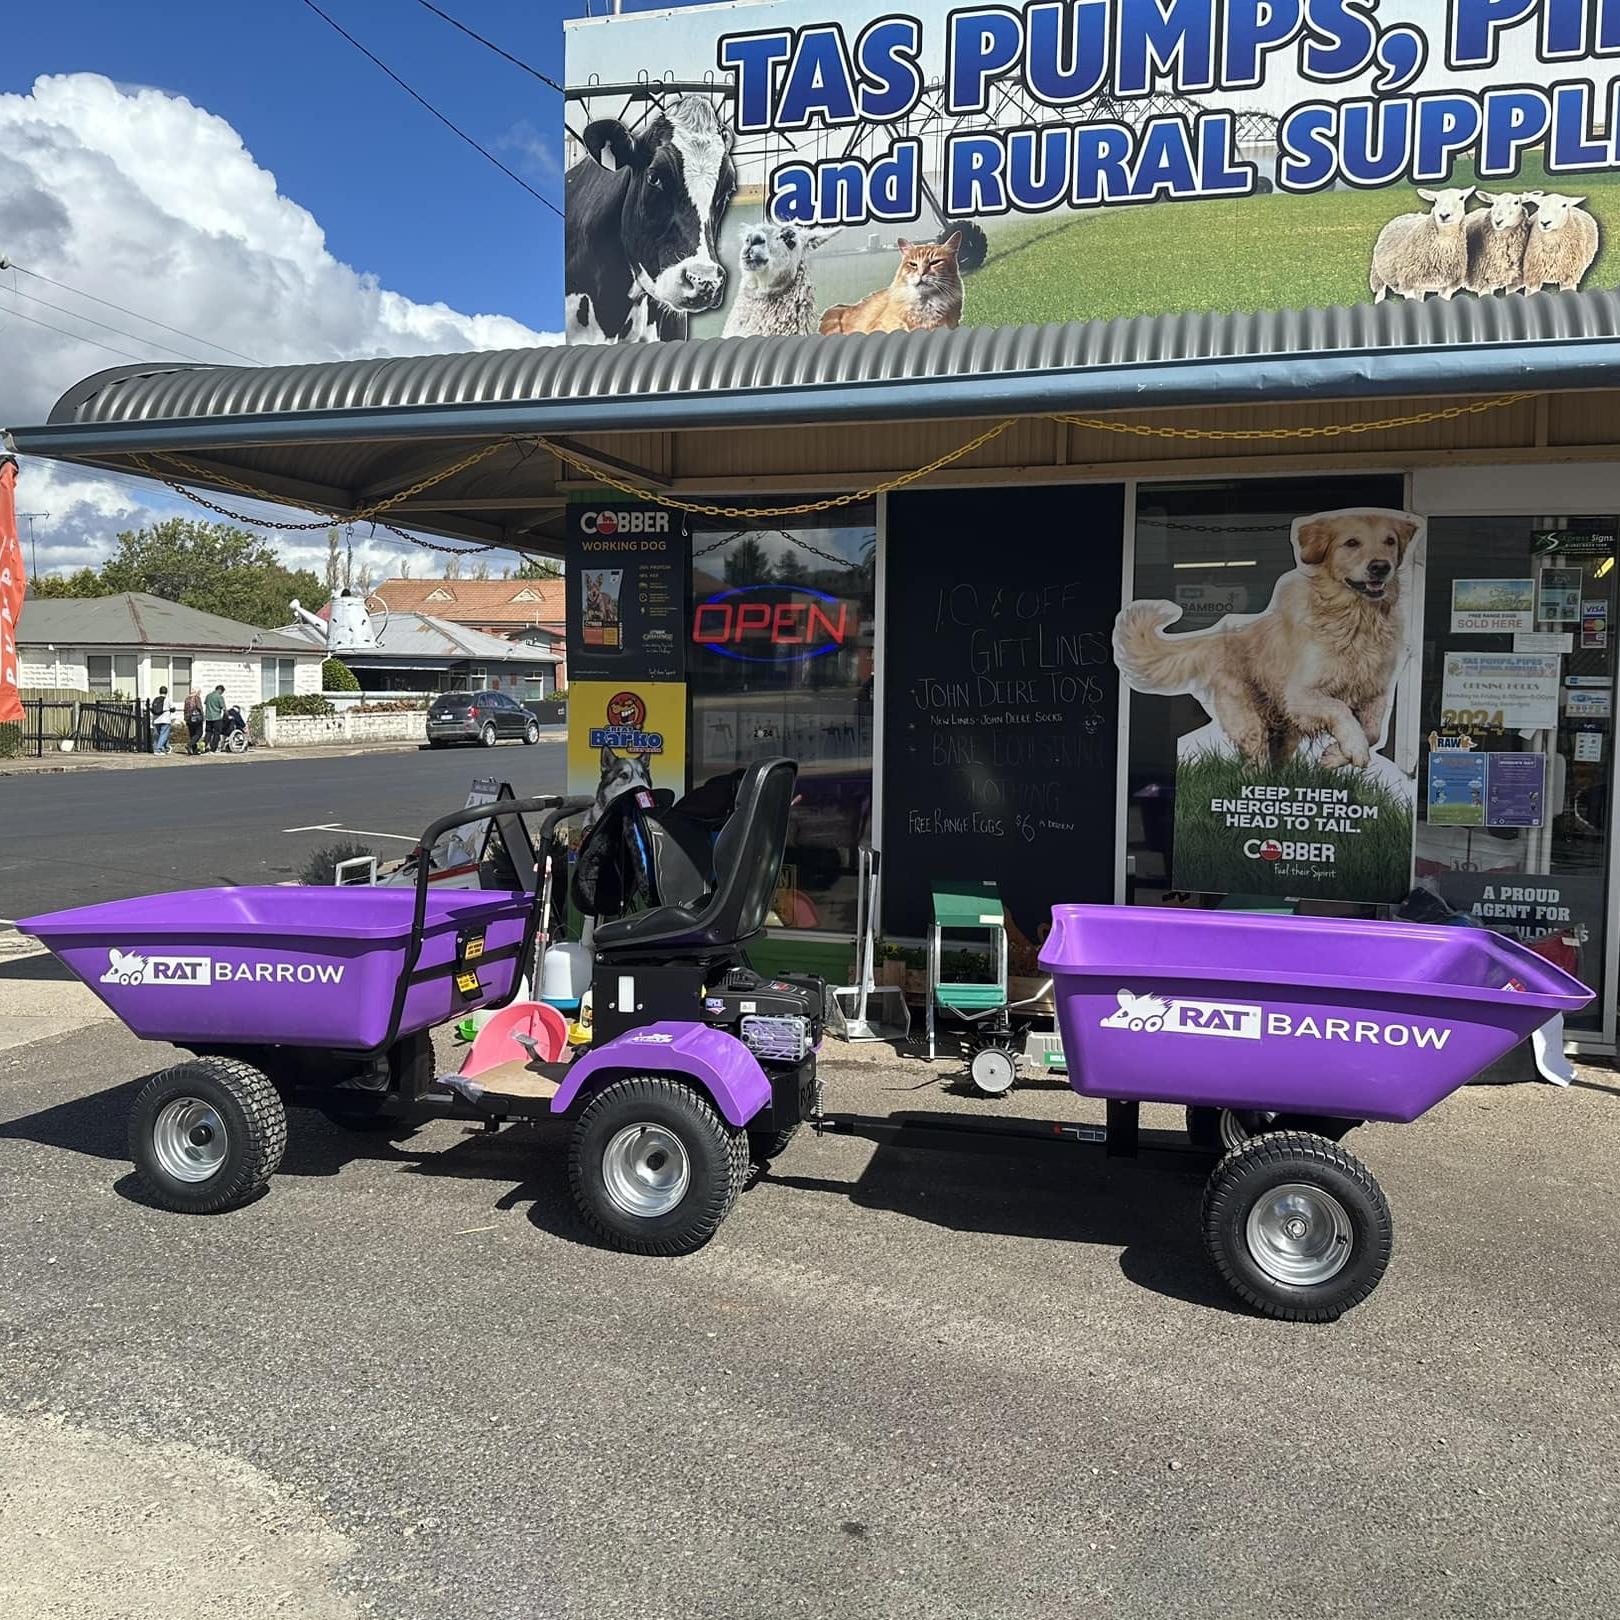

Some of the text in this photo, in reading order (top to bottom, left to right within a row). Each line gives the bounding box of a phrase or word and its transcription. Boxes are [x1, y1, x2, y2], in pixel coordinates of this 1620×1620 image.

[717, 0, 1620, 133] TAS PUMPS, PI
[766, 78, 1620, 226] and RURAL SUPPL
[580, 511, 669, 534] COBBER
[582, 541, 667, 552] WORKING DOG
[1016, 582, 1081, 619] OFF
[1181, 602, 1233, 612] BAMBOO
[1586, 605, 1605, 613] VISA
[693, 603, 847, 644] OPEN
[1458, 619, 1523, 629] SOLD HERE
[970, 623, 1109, 675] GIFT LINES
[915, 671, 1105, 711] JOHN DEERE TOYS
[980, 714, 1004, 725] JOHN
[1035, 711, 1063, 723] SOCKS
[1442, 709, 1504, 736] 2024
[590, 728, 663, 748] Barko
[1437, 738, 1461, 748] RAW
[1241, 785, 1348, 803] KEEP THEM
[1211, 799, 1378, 819] ENERGISED FROM
[908, 809, 931, 834] FREE
[934, 808, 969, 834] RANGE
[972, 811, 1004, 836] EGGS
[1016, 813, 1036, 842] $6
[1226, 815, 1361, 833] HEAD TO TAIL.
[1243, 838, 1336, 863] COBBER
[1274, 863, 1337, 881] Fuel their Spirit
[1482, 886, 1560, 903] A PROUD
[1471, 902, 1570, 921] AGENT FOR
[153, 961, 345, 984] RAT BARROW
[1179, 1006, 1451, 1050] RAT BARROW
